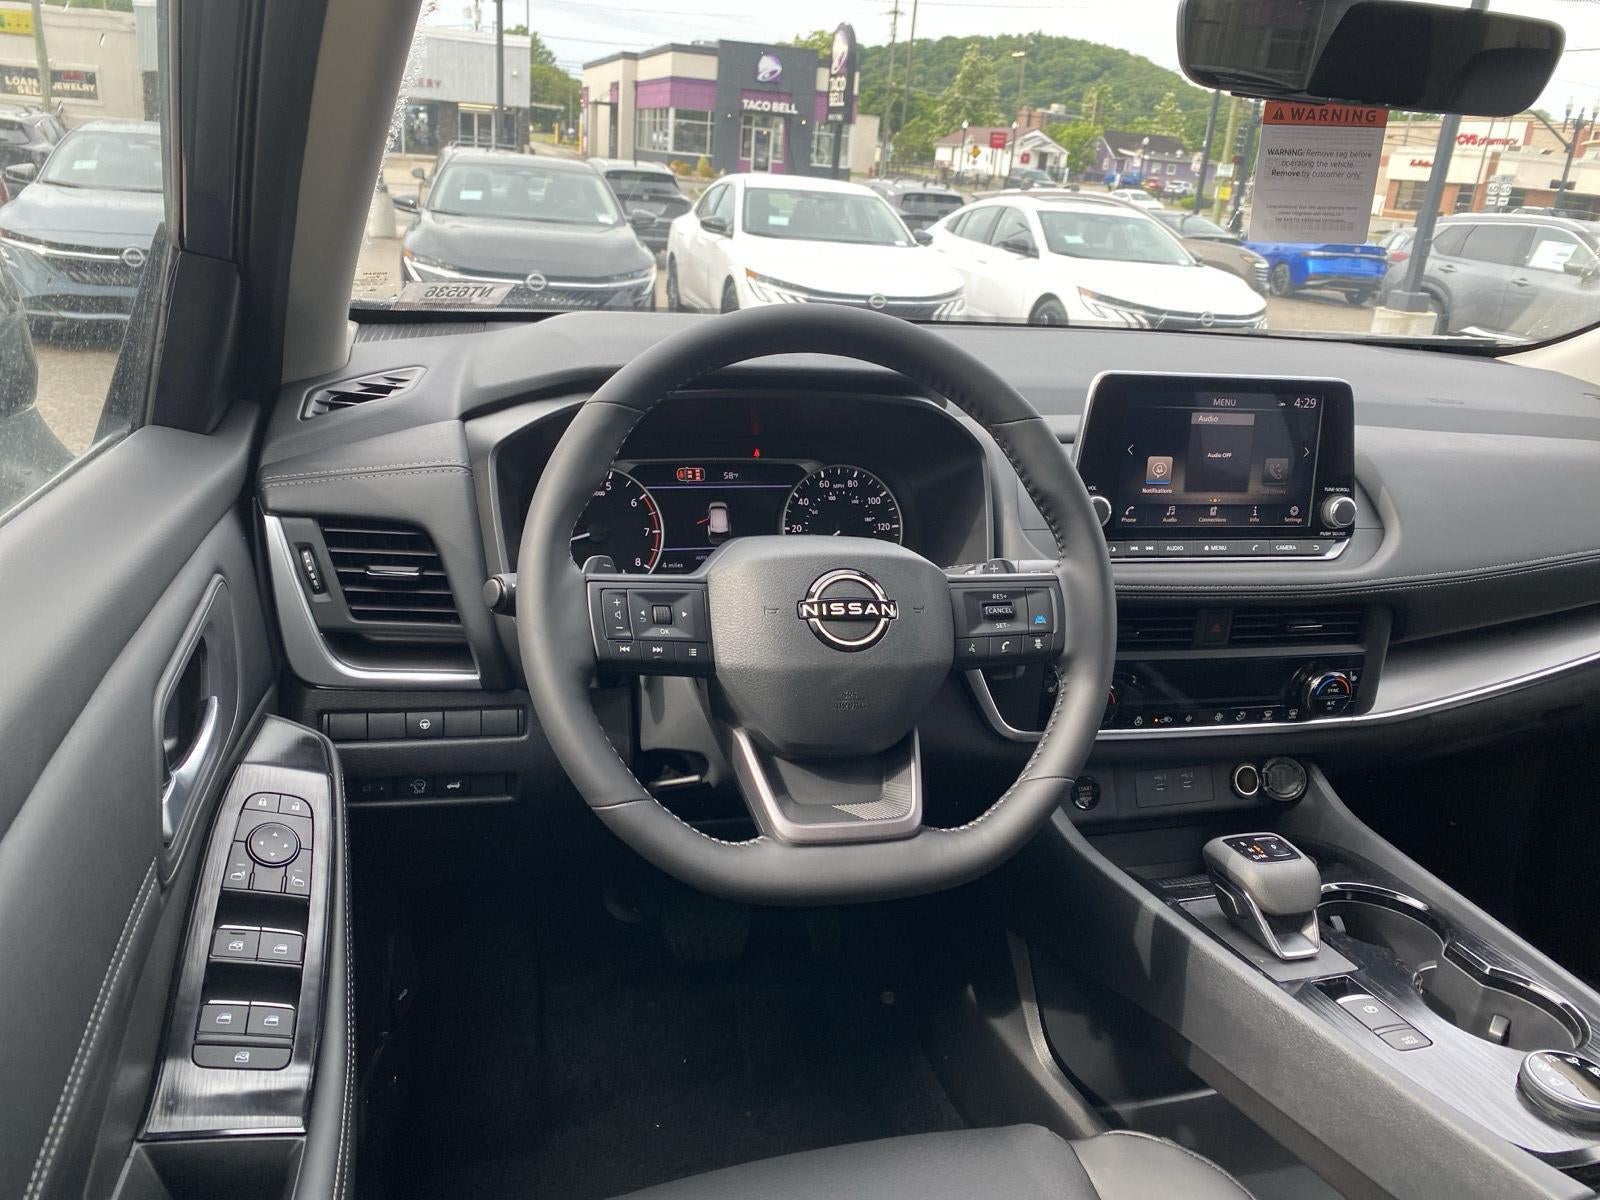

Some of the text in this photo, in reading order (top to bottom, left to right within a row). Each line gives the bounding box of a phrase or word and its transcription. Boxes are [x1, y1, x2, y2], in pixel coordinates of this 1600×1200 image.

[52, 81, 96, 93] JEWELRY
[829, 91, 845, 107] BELL
[742, 99, 798, 115] TACO BELL
[1291, 107, 1376, 122] WARNING
[1456, 134, 1478, 146] CVS
[1305, 149, 1334, 158] Remove
[1349, 150, 1372, 158] before
[1281, 160, 1315, 169] operating
[1316, 160, 1329, 168] the
[1271, 169, 1300, 177] Remove
[1301, 170, 1310, 178] by
[1311, 171, 1344, 179] customer
[1213, 398, 1237, 407] MENU
[1293, 397, 1317, 409] 4:29
[1198, 415, 1219, 423] Audio
[605, 481, 613, 492] 5
[819, 480, 830, 489] 60
[847, 479, 859, 489] 80
[1142, 487, 1173, 495] Notifications
[630, 499, 637, 508] 6
[797, 498, 810, 506] 40
[867, 497, 881, 505] 100
[1284, 516, 1303, 524] Settings
[791, 524, 803, 533] 20
[877, 522, 891, 531] 120
[643, 527, 650, 537] 7
[634, 557, 642, 567] 8
[668, 561, 684, 569] miles
[802, 602, 896, 617] NISSAN
